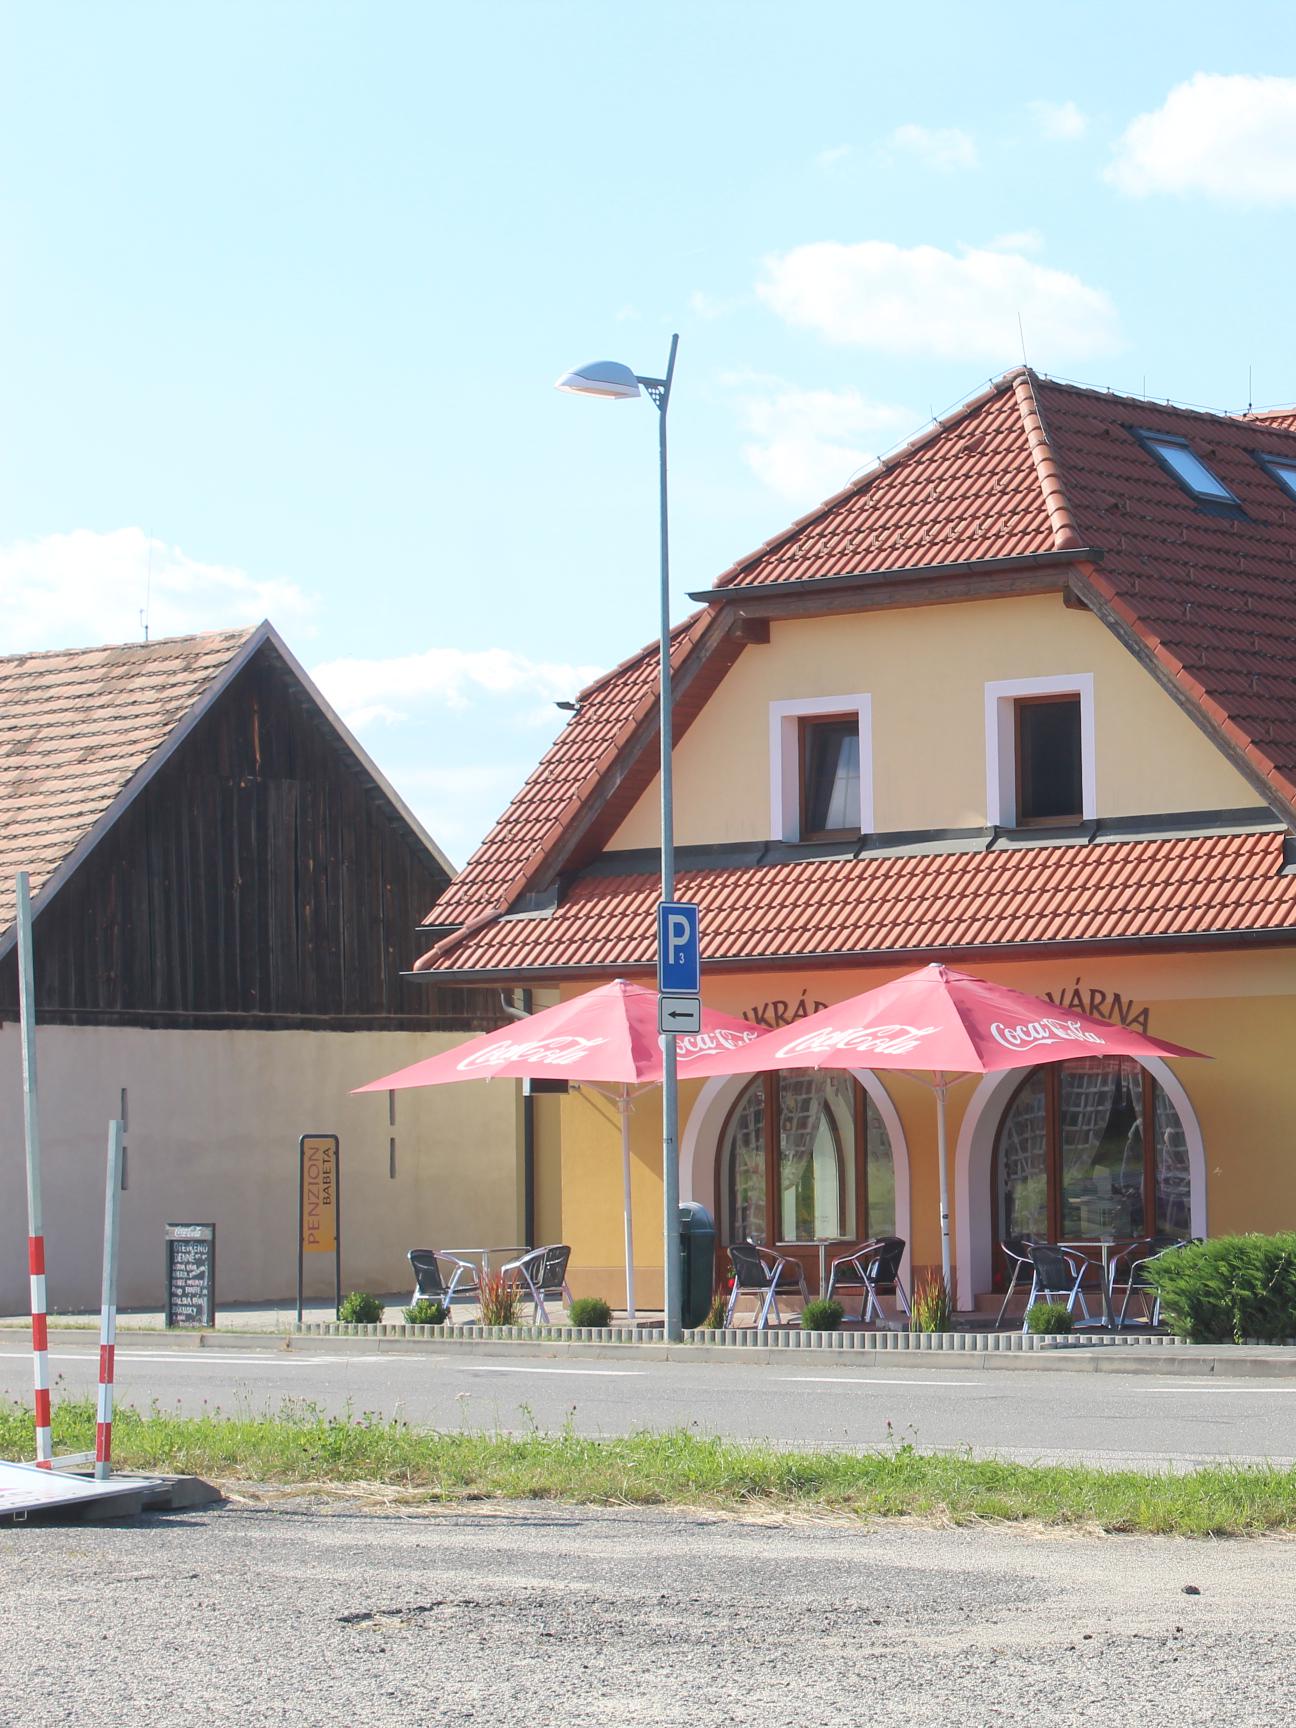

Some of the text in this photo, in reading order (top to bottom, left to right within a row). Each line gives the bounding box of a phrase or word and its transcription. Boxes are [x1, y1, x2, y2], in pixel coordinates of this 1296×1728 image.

[668, 914, 691, 965] P
[679, 952, 685, 965] 3
[1043, 976, 1150, 1036] VÁRNA
[307, 1147, 320, 1245] PENZION
[322, 1147, 332, 1205] BABETA
